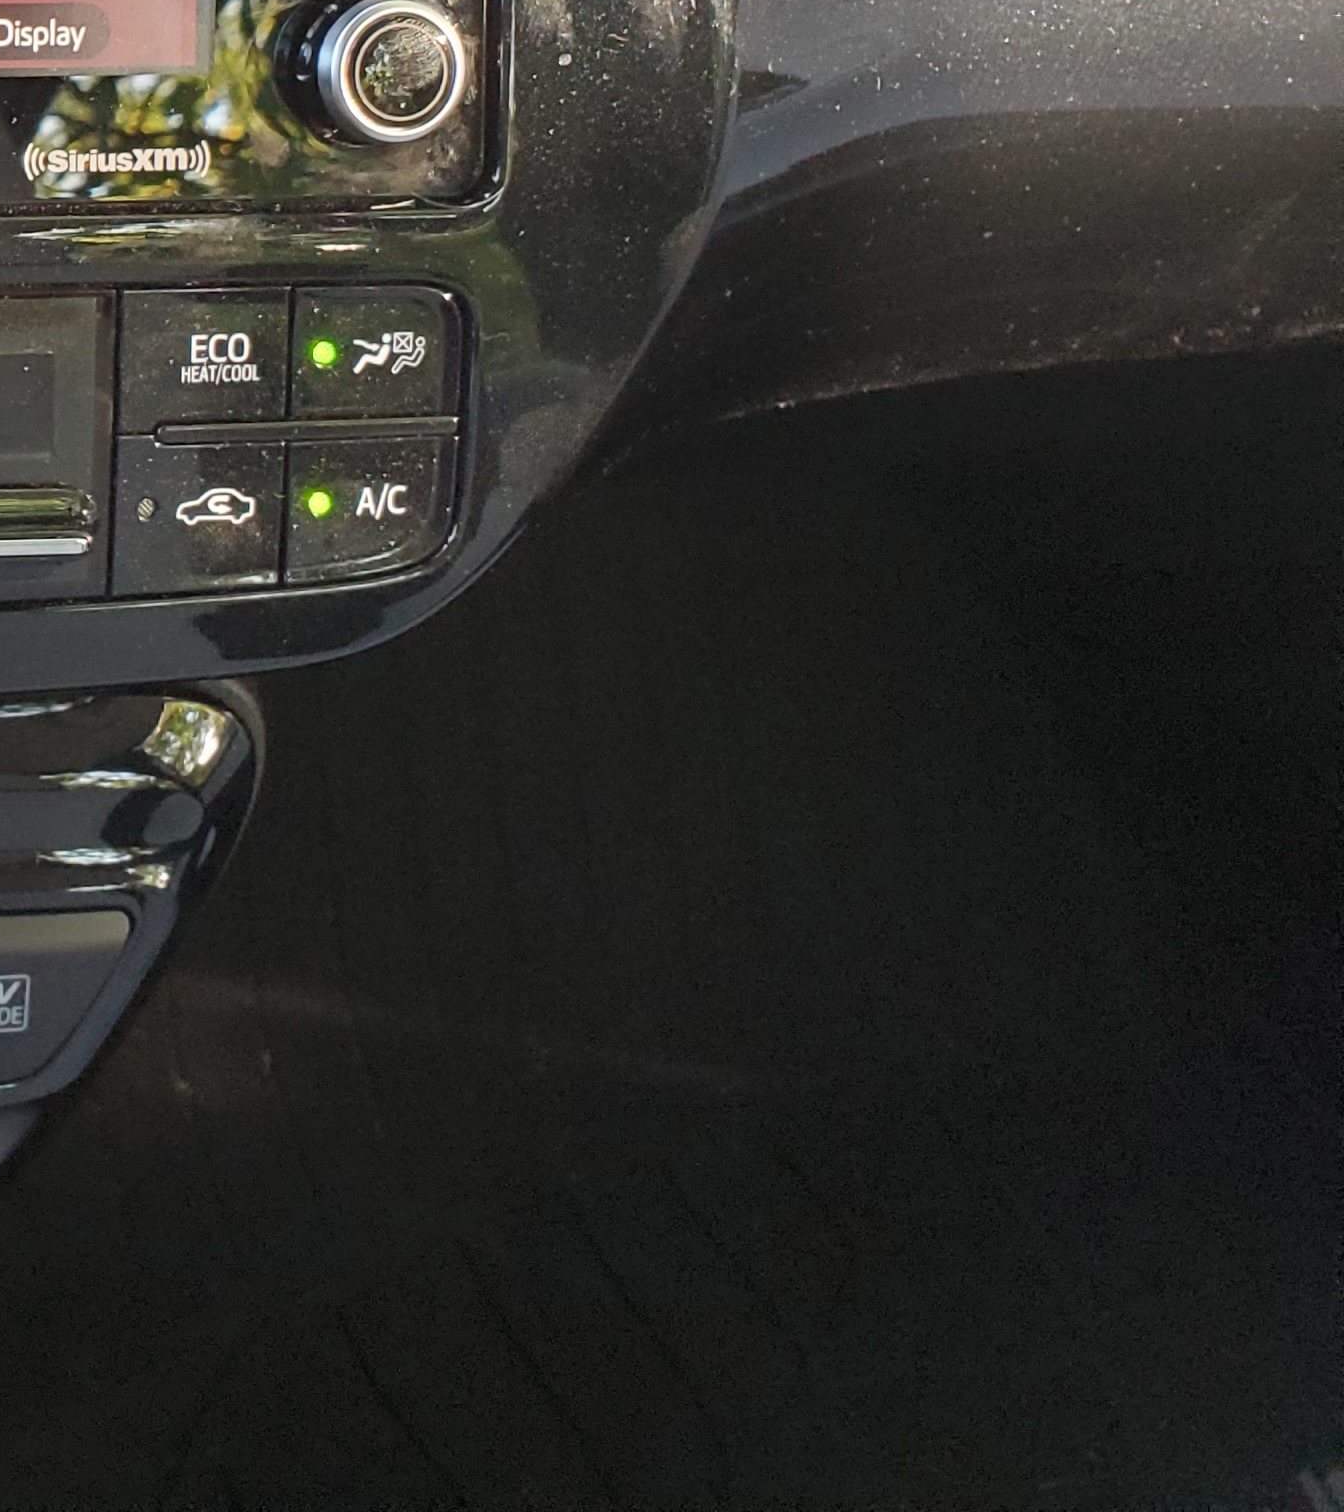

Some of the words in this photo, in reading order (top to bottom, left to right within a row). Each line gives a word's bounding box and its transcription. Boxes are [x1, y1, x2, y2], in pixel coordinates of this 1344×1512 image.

[190, 333, 250, 363] ECO
[181, 363, 260, 385] HEAT/COOL
[355, 483, 407, 520] A/C
